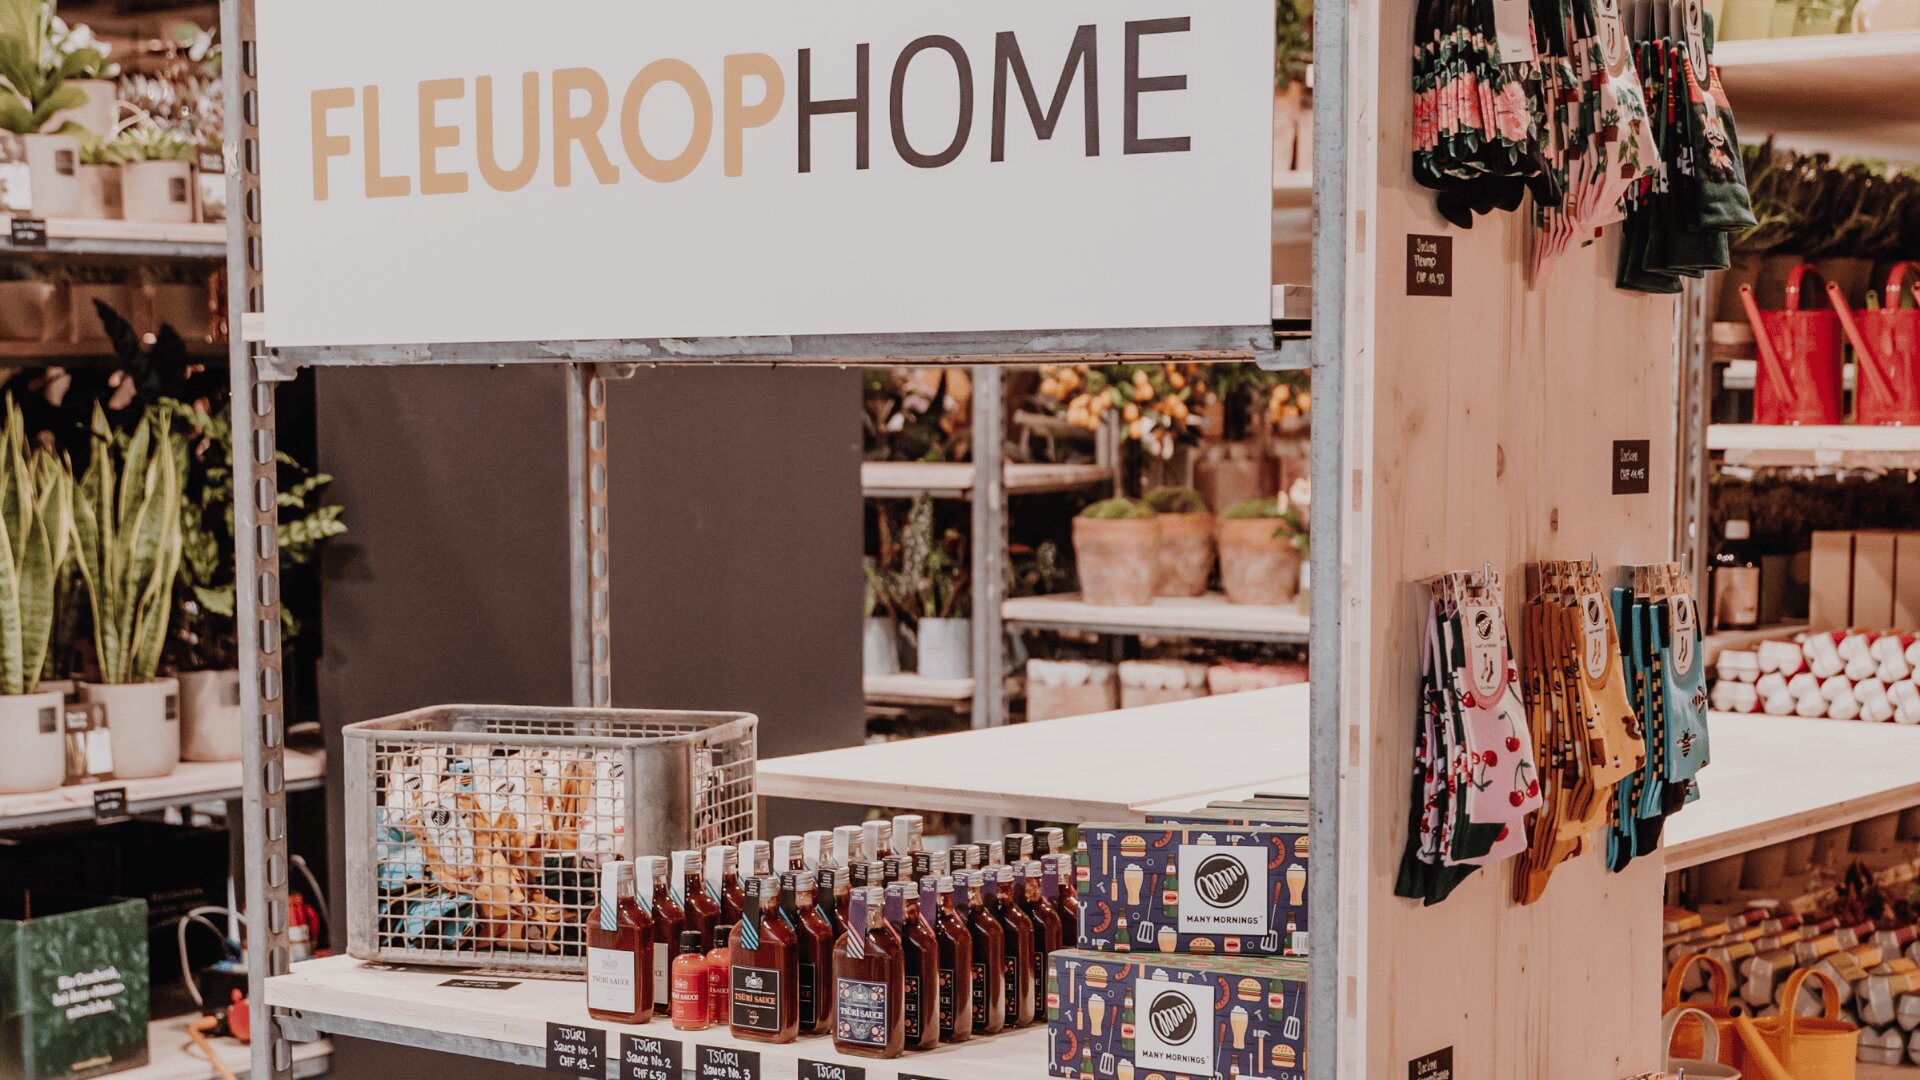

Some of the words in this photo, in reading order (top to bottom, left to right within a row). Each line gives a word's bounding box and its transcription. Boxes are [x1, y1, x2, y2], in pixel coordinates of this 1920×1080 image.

[1416, 271, 1427, 283] CHF
[1620, 468, 1630, 480] CHF
[1186, 914, 1211, 923] MANY
[1213, 915, 1259, 925] MORNINGS
[609, 977, 630, 986] SAUCE
[754, 995, 776, 1005] SAUCE
[860, 1009, 884, 1020] SAUCE
[554, 1040, 576, 1055] Sauce
[560, 1055, 575, 1068] CHF
[626, 1051, 649, 1066] Sauce
[1142, 1050, 1164, 1060] MANY
[1165, 1053, 1206, 1065] MORNINGS
[633, 1067, 648, 1079] CHF
[703, 1064, 727, 1077] Sauce
[743, 1069, 751, 1080] 3
